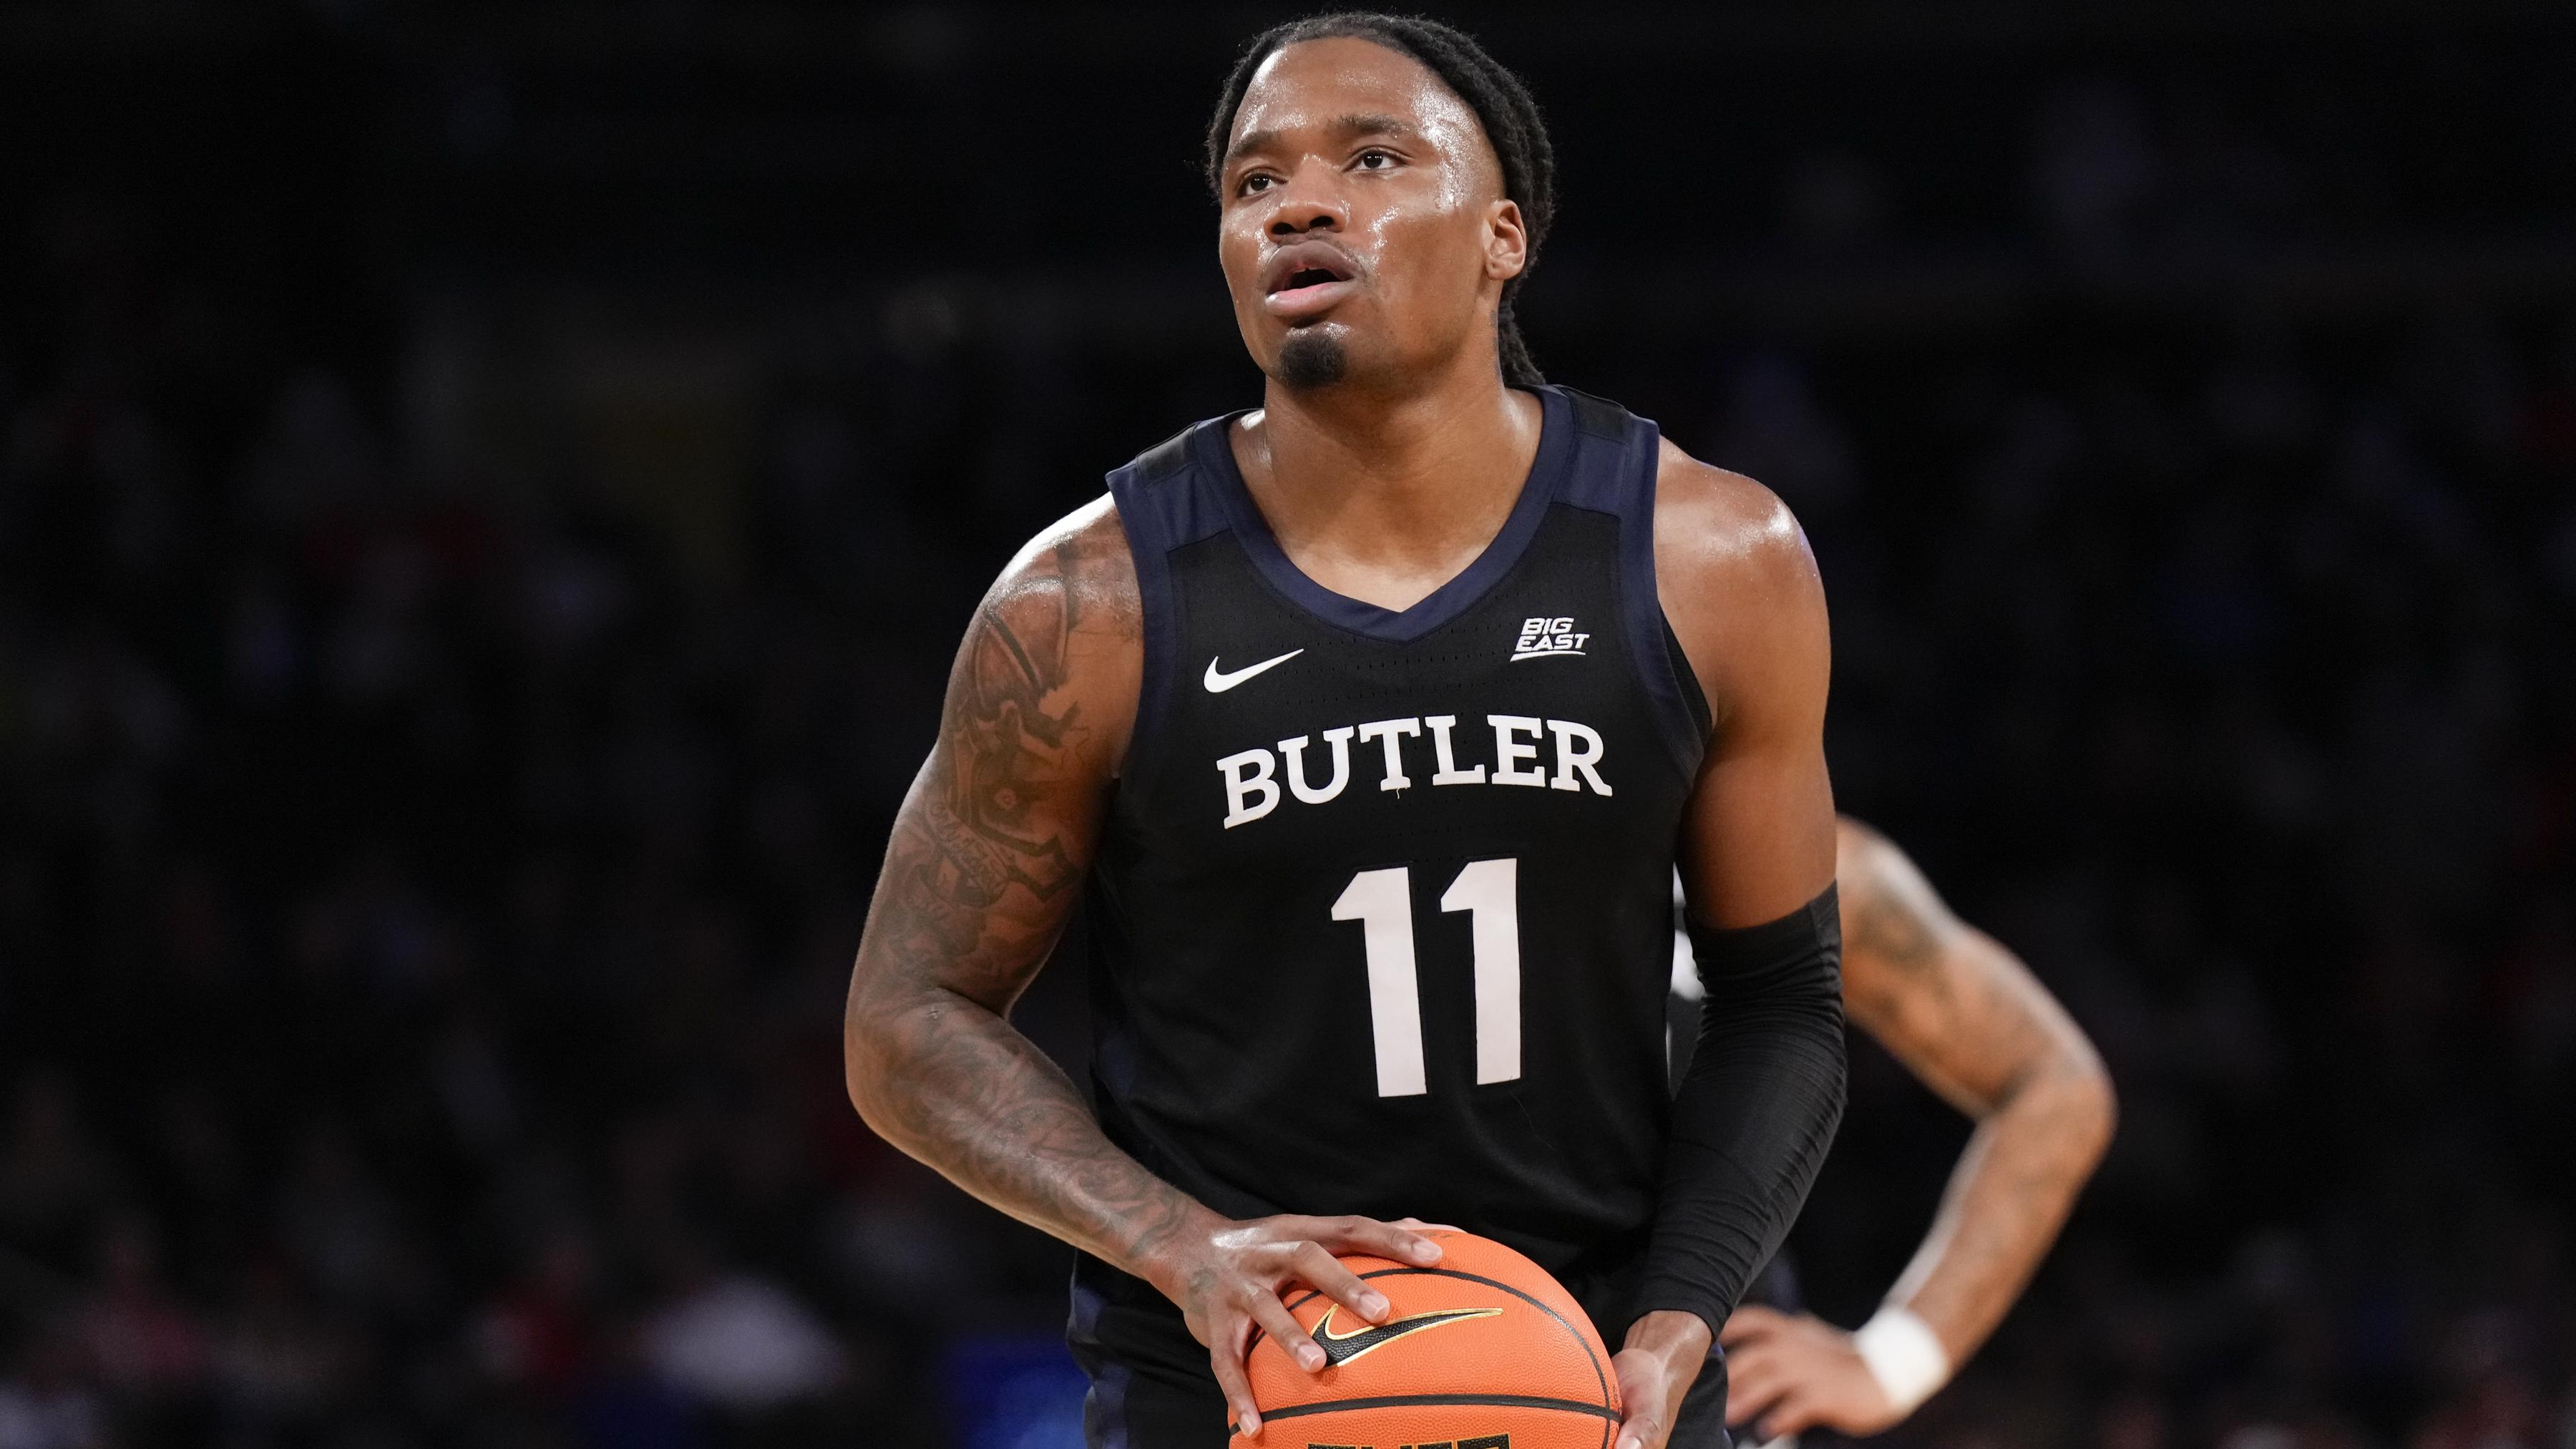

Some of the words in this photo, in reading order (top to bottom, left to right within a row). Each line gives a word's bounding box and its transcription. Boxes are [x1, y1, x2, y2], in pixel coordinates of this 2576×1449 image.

[1515, 633, 1590, 652] EAST
[1521, 617, 1574, 635] BIG
[1216, 714, 1613, 829] BUTLER
[1331, 858, 1521, 1098] 11
